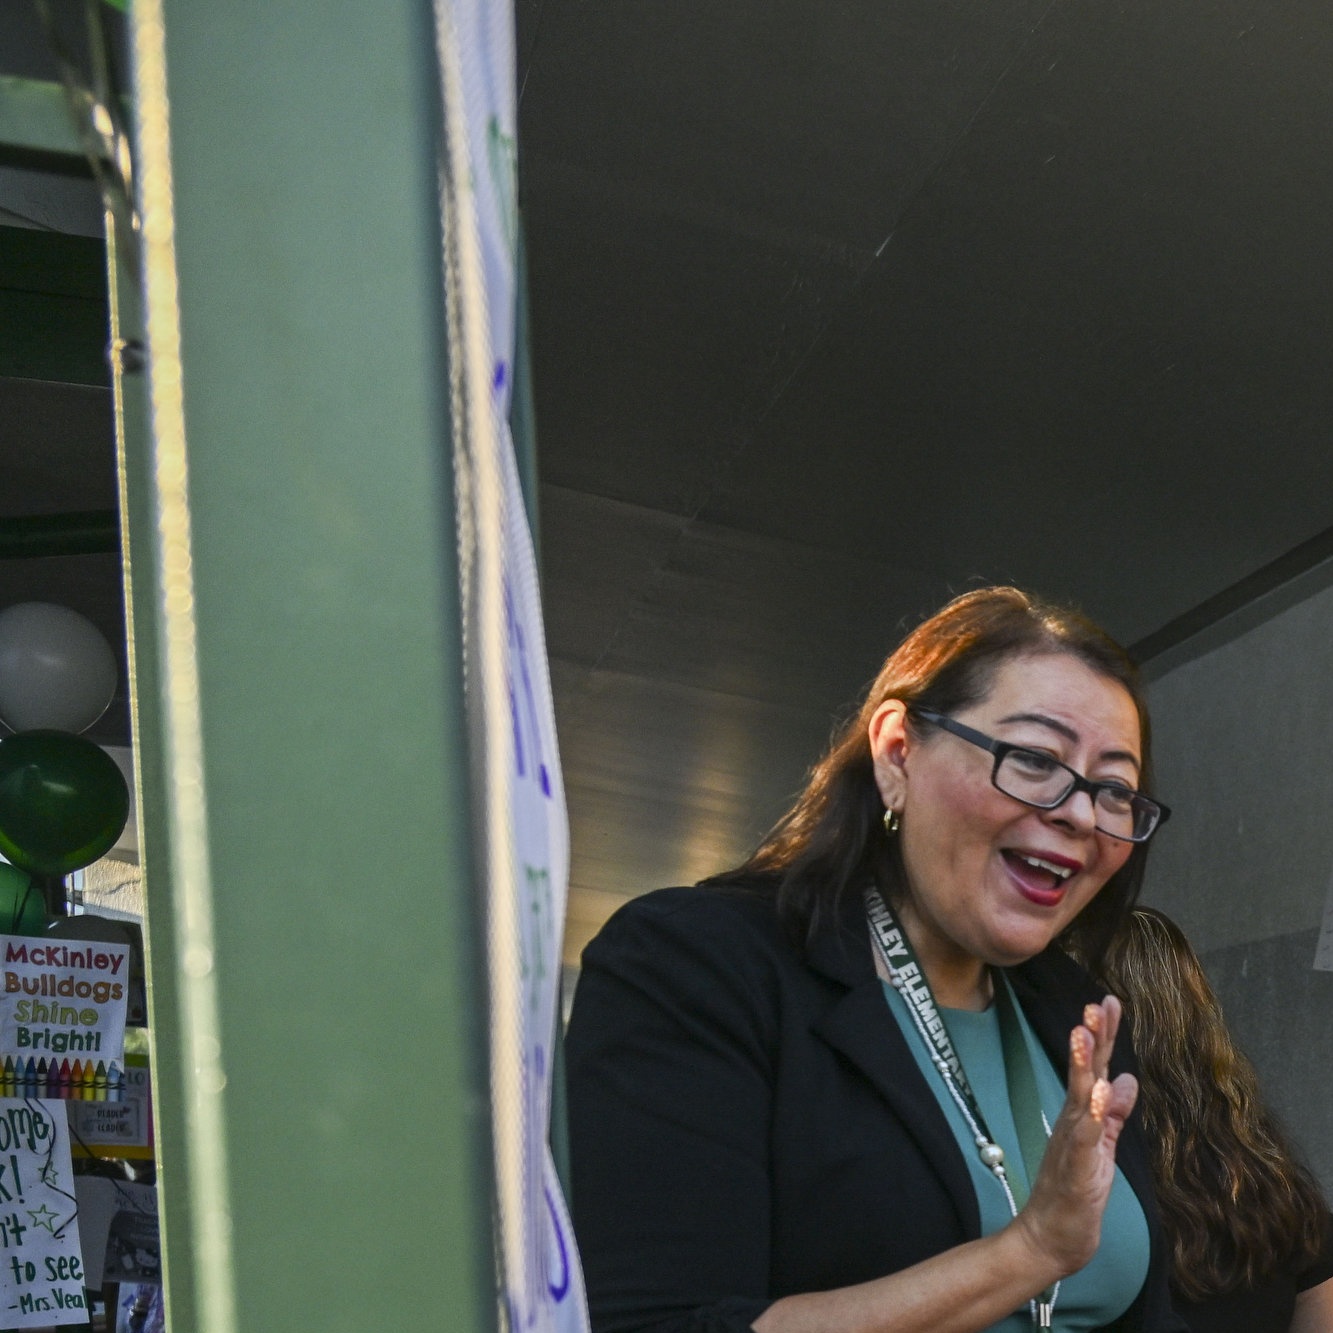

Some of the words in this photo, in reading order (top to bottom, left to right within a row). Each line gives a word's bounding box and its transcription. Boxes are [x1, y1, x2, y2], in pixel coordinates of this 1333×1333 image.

[865, 887, 909, 957] KINLEY
[6, 942, 124, 975] McKinley
[5, 971, 123, 1004] Bulldogs
[13, 999, 98, 1026] Shine
[17, 1027, 101, 1053] Bright!
[10, 1256, 36, 1285] to
[45, 1256, 83, 1282] see
